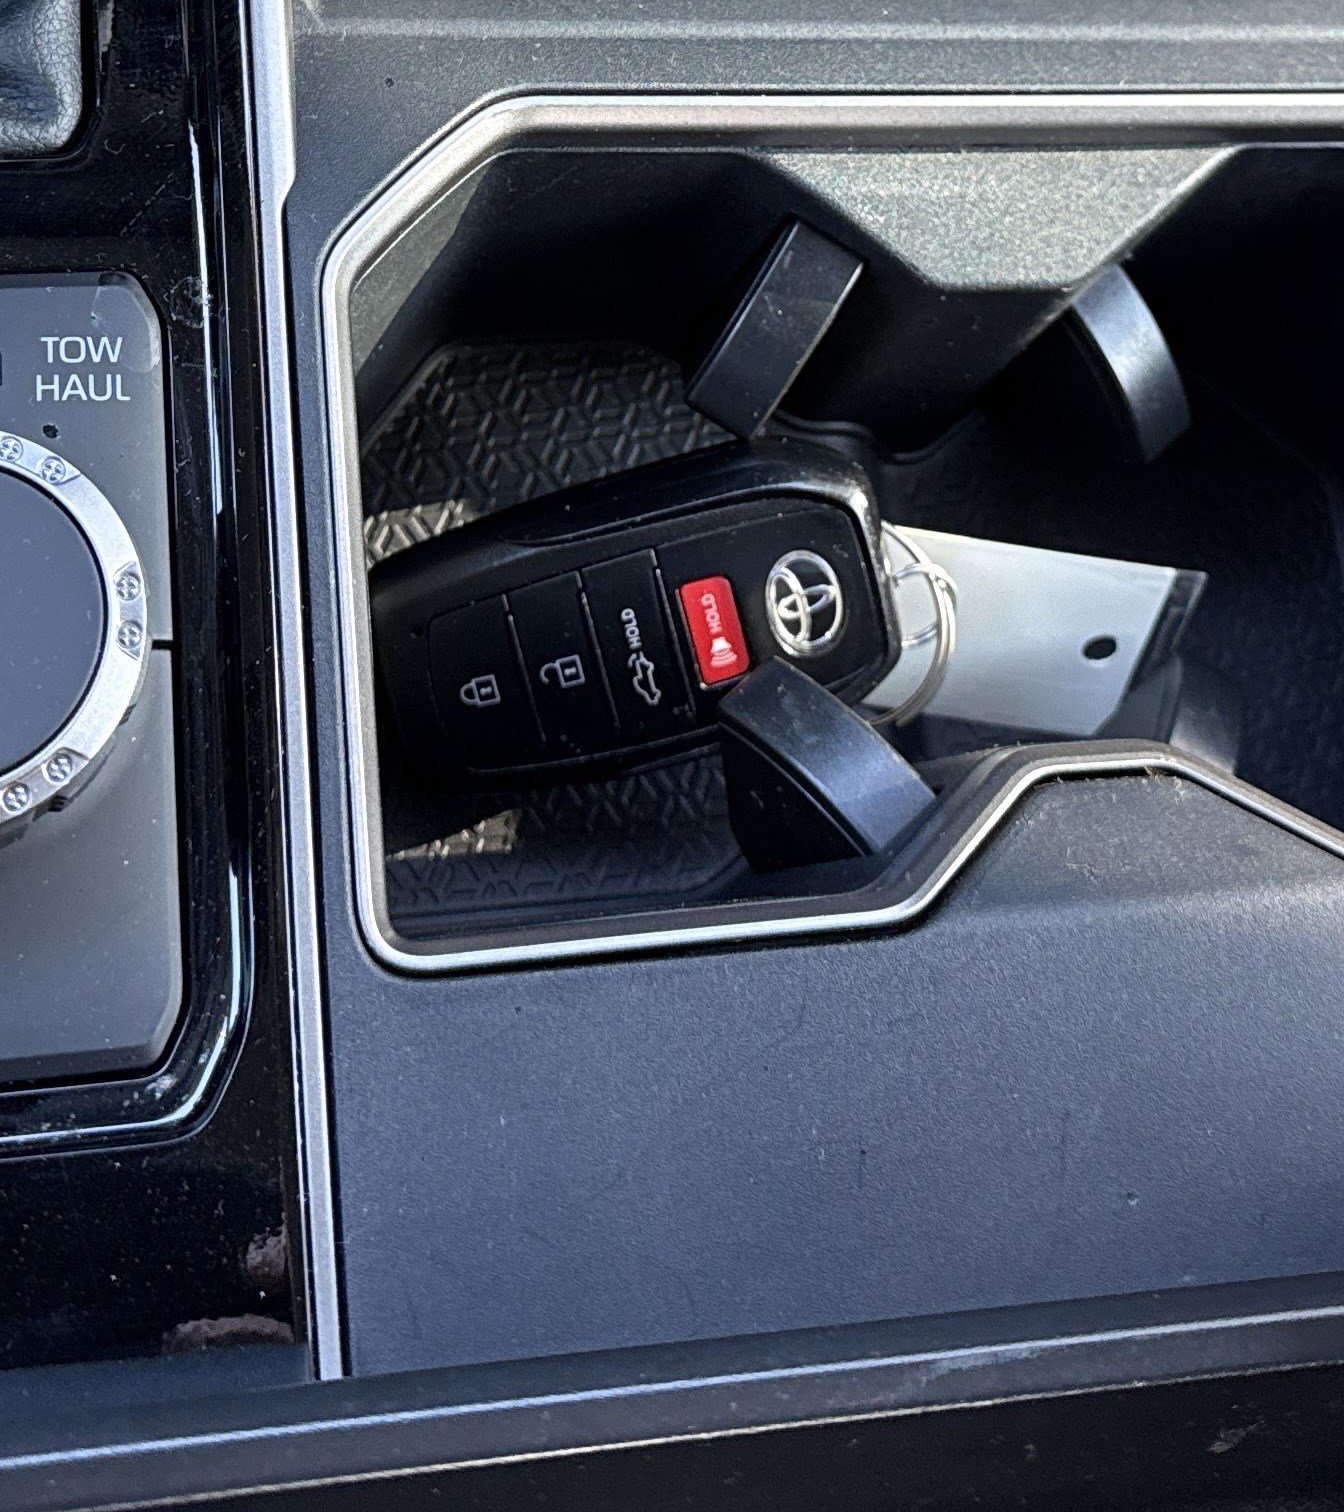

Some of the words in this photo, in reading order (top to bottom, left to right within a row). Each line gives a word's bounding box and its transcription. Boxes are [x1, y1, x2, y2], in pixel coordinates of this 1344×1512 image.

[40, 336, 123, 364] TOW
[35, 374, 131, 402] HAUL
[621, 608, 642, 650] HOLD
